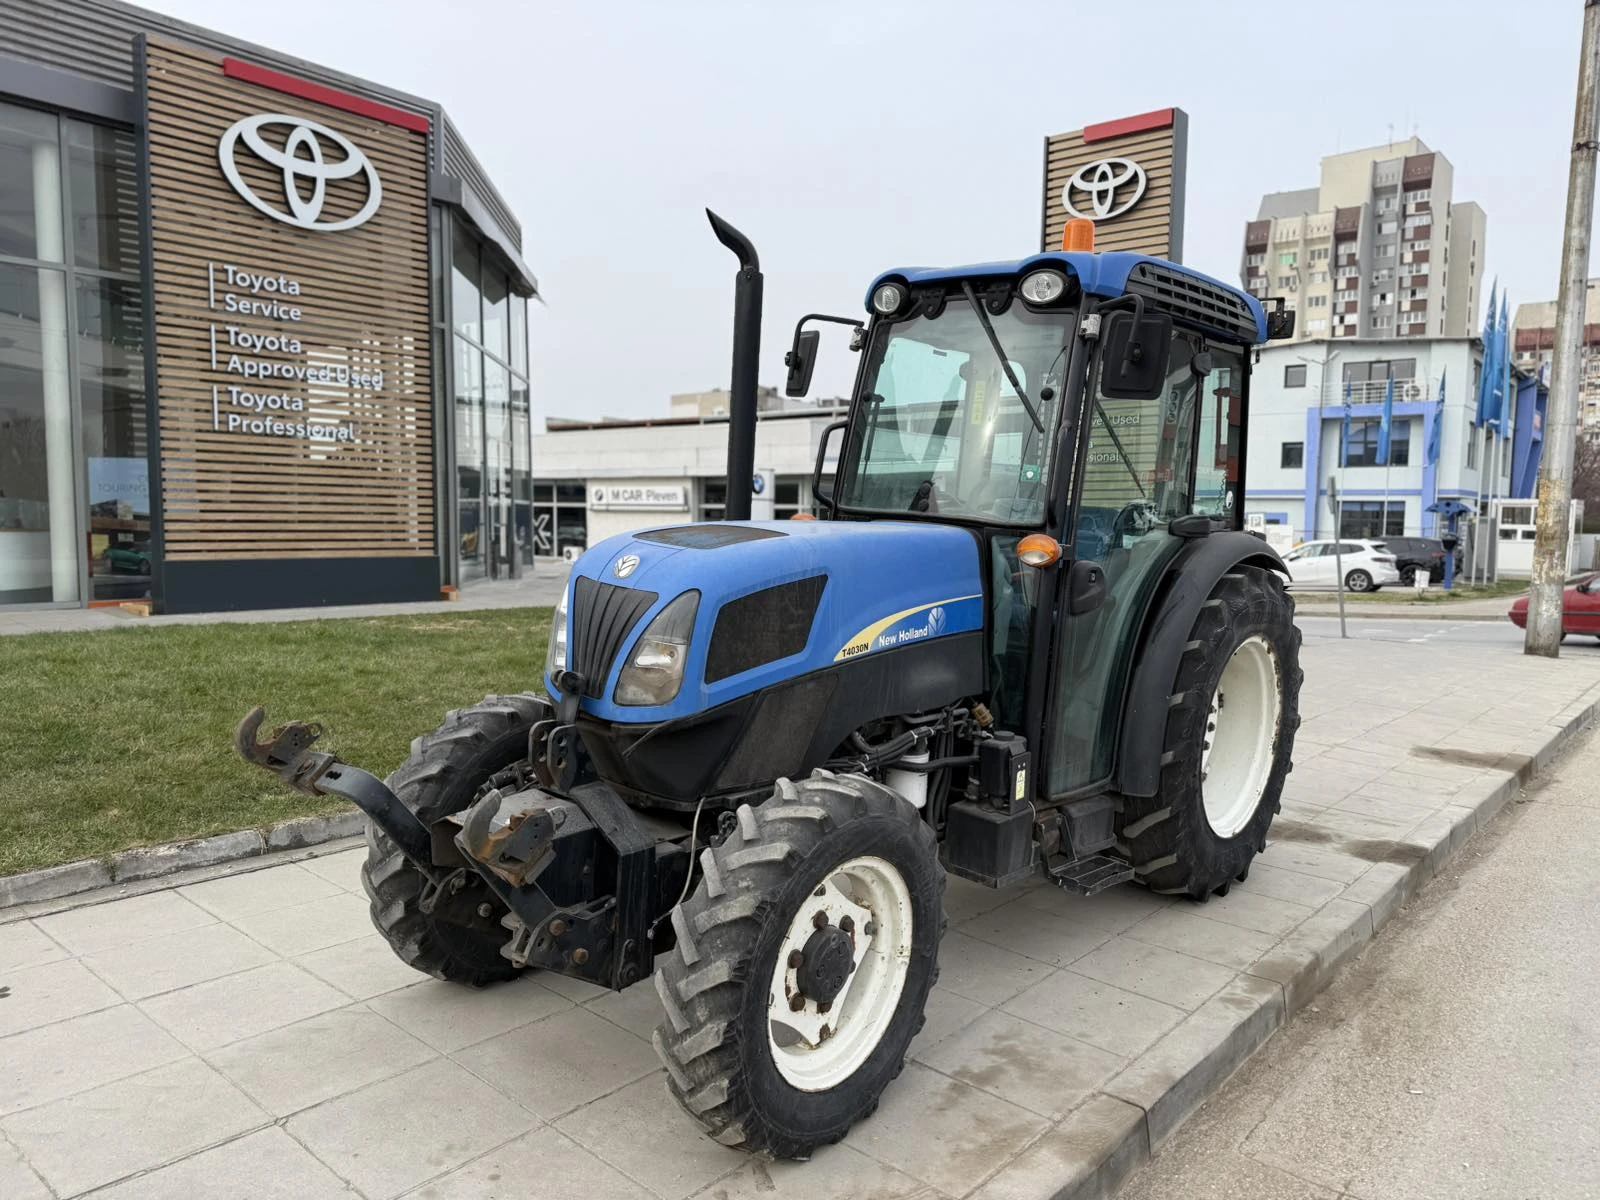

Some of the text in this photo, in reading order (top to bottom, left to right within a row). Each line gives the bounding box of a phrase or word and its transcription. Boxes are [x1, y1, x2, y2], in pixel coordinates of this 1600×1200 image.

[224, 265, 300, 295] Toyota
[225, 294, 301, 320] Service
[226, 326, 302, 353] Toyota
[228, 354, 383, 388] Approved Used
[228, 386, 304, 412] Toyota
[228, 414, 355, 440] Professional
[1112, 413, 1140, 425] Used
[622, 489, 642, 501] CAR
[646, 489, 678, 501] Pleven
[842, 625, 928, 657] T4030N New Holland
